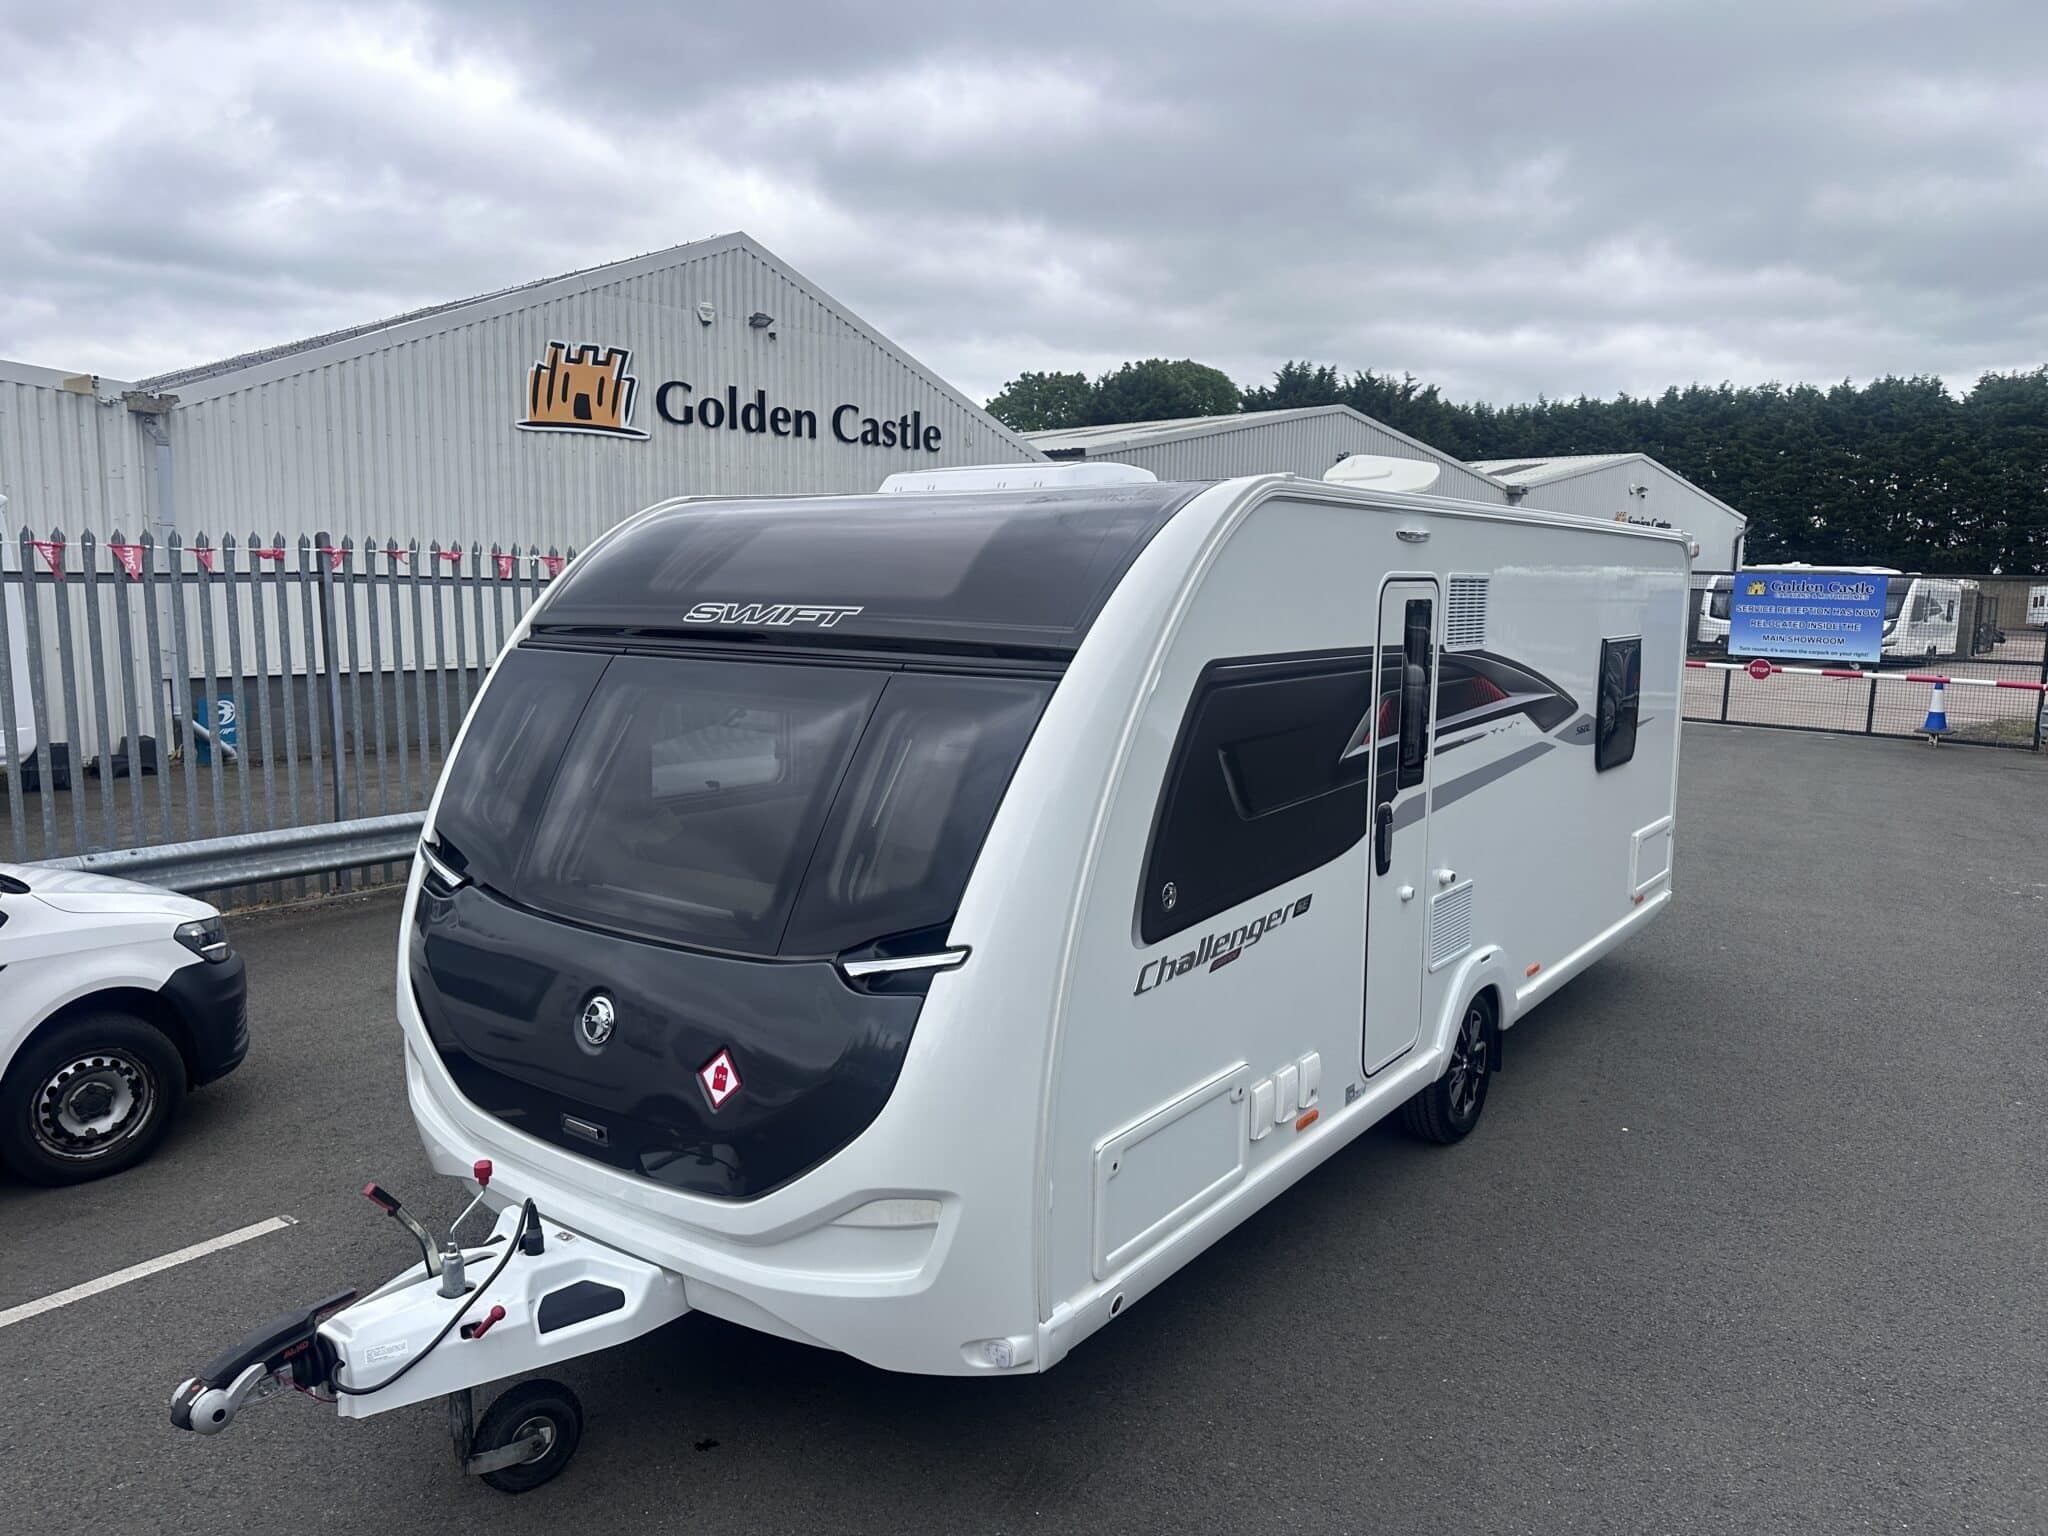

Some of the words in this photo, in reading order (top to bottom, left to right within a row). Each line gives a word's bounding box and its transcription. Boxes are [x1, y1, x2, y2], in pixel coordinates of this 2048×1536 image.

[655, 380, 817, 440] Golden
[831, 404, 942, 453] Castle
[1771, 580, 1824, 593] Golden
[1828, 581, 1875, 595] Castle
[683, 603, 864, 627] SWIFT
[1736, 604, 1775, 613] SERVICE
[1777, 605, 1831, 615] RECEPTION
[1832, 607, 1854, 616] HAS
[1855, 608, 1880, 617] NOW
[1750, 619, 1806, 629] RELOCATED
[1807, 621, 1840, 630] INSIDE
[1842, 623, 1861, 631] THE
[1762, 634, 1785, 642] MAIN
[1787, 635, 1845, 645] SHOWROOM
[1133, 901, 1295, 996] Challenger
